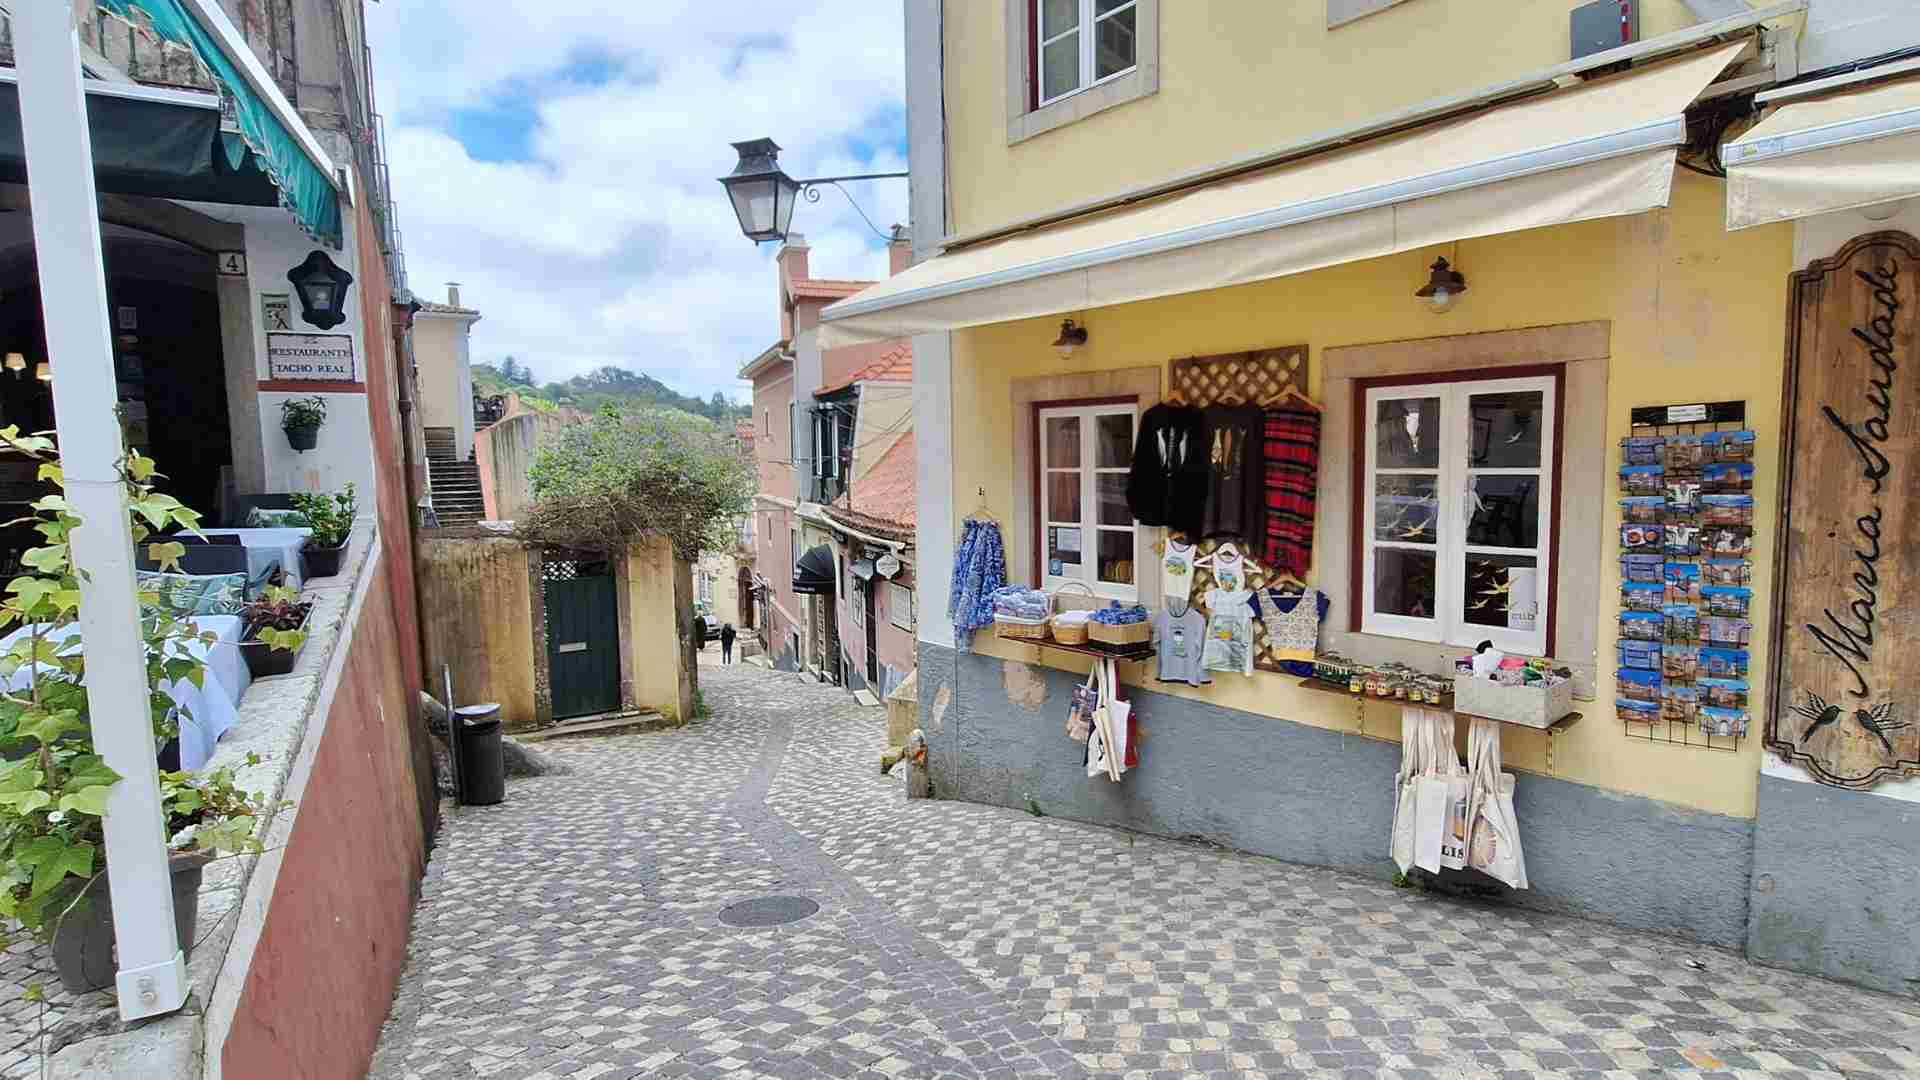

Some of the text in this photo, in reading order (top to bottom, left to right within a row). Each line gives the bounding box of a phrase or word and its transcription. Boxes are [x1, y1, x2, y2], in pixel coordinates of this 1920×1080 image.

[226, 254, 239, 272] 4
[276, 364, 346, 373] TACHO REAL
[1806, 257, 1899, 699] Maria Saudade
